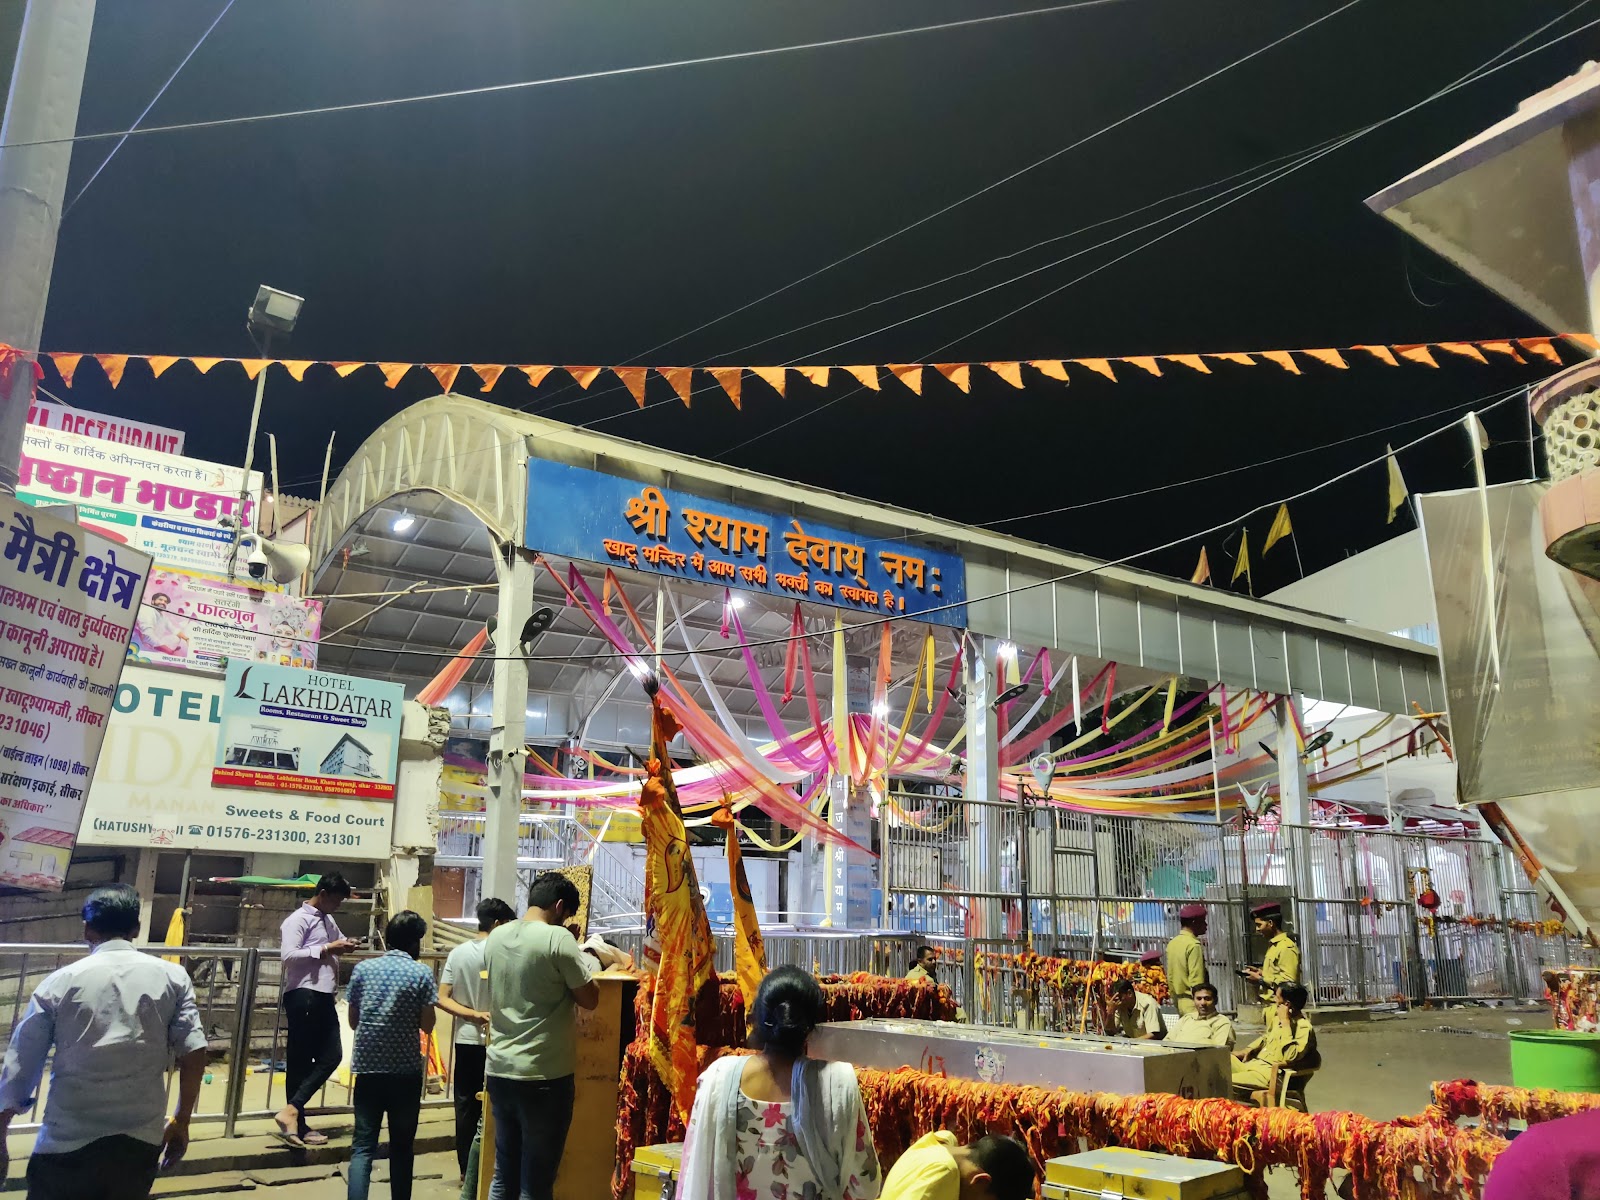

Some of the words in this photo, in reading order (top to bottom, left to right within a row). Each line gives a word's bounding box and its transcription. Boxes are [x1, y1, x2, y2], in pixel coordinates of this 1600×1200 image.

[55, 443, 68, 454] का
[73, 445, 107, 460] हार्दिक
[109, 453, 161, 472] अभिन्नदन
[163, 463, 193, 479] करता
[136, 479, 255, 527] भण्डार
[624, 486, 670, 539] श्री
[681, 507, 768, 558] श्याम
[783, 519, 868, 587] देवाय्
[4, 512, 80, 588] मैत्री
[78, 549, 142, 610] क्षेत्र
[602, 538, 638, 566] खाटू
[641, 543, 686, 568] मन्दिर
[690, 551, 705, 571] में
[707, 559, 735, 577] आप
[738, 564, 768, 584] सभी
[814, 580, 833, 596] का
[839, 585, 878, 605] स्वागत
[0, 585, 39, 614] ालश्रम
[38, 598, 61, 620] एवं
[58, 605, 83, 628] बाल
[197, 602, 256, 625] फाल्गुन
[6, 623, 49, 655] कानूनी
[47, 636, 91, 664] अपराध
[19, 662, 45, 682] कानूनी
[45, 668, 78, 690] कार्यवाही
[78, 676, 89, 691] की
[307, 674, 355, 692] HOTEL
[261, 682, 392, 719] LAKHDATAR
[75, 705, 104, 728] सीकर
[260, 705, 284, 716] Rooms,
[286, 709, 322, 720] Restaurant
[330, 715, 350, 724] Sweet
[351, 717, 367, 727] Shop
[24, 752, 45, 767] लाइन
[44, 754, 71, 775] (1098)
[71, 761, 90, 778] सीकर
[0, 796, 12, 808] का
[60, 783, 83, 801] सीकर
[225, 805, 283, 820] Sweets
[289, 809, 300, 821] &
[306, 811, 340, 824] Food
[345, 815, 385, 827] Court
[206, 825, 310, 844] 01576-231300,
[315, 832, 361, 846] 231301
